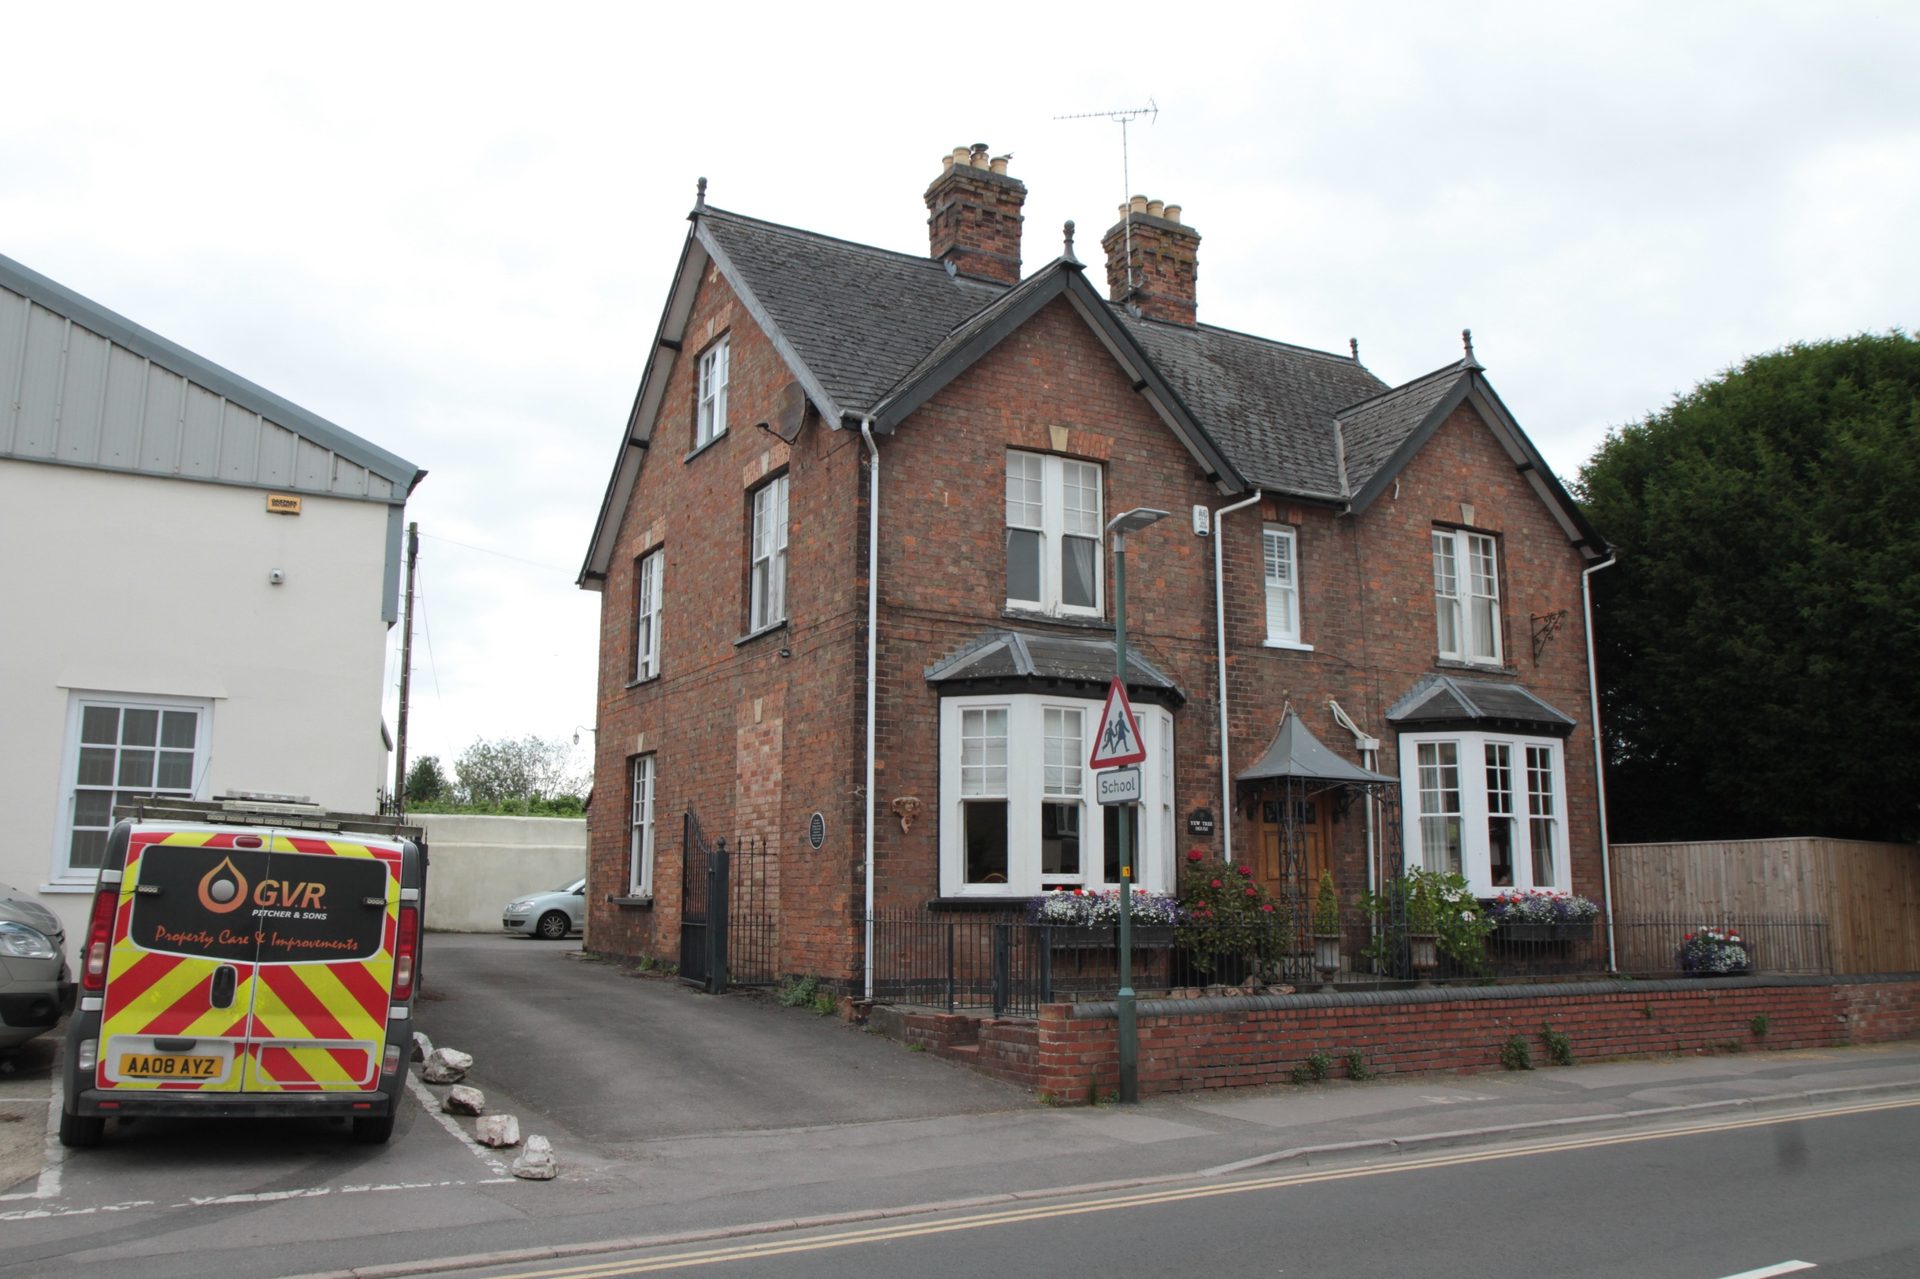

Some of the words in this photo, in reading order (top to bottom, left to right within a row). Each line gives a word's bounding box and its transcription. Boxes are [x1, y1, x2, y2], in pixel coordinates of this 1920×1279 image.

[1101, 777, 1135, 794] School
[252, 909, 292, 919] PITCHER
[293, 911, 300, 919] &
[302, 912, 327, 920] SONS
[155, 925, 214, 948] Property
[218, 929, 249, 945] Care
[255, 931, 266, 944] &
[271, 931, 358, 951] Improvements
[127, 1057, 175, 1074] AA08
[180, 1059, 215, 1075] AYZ
